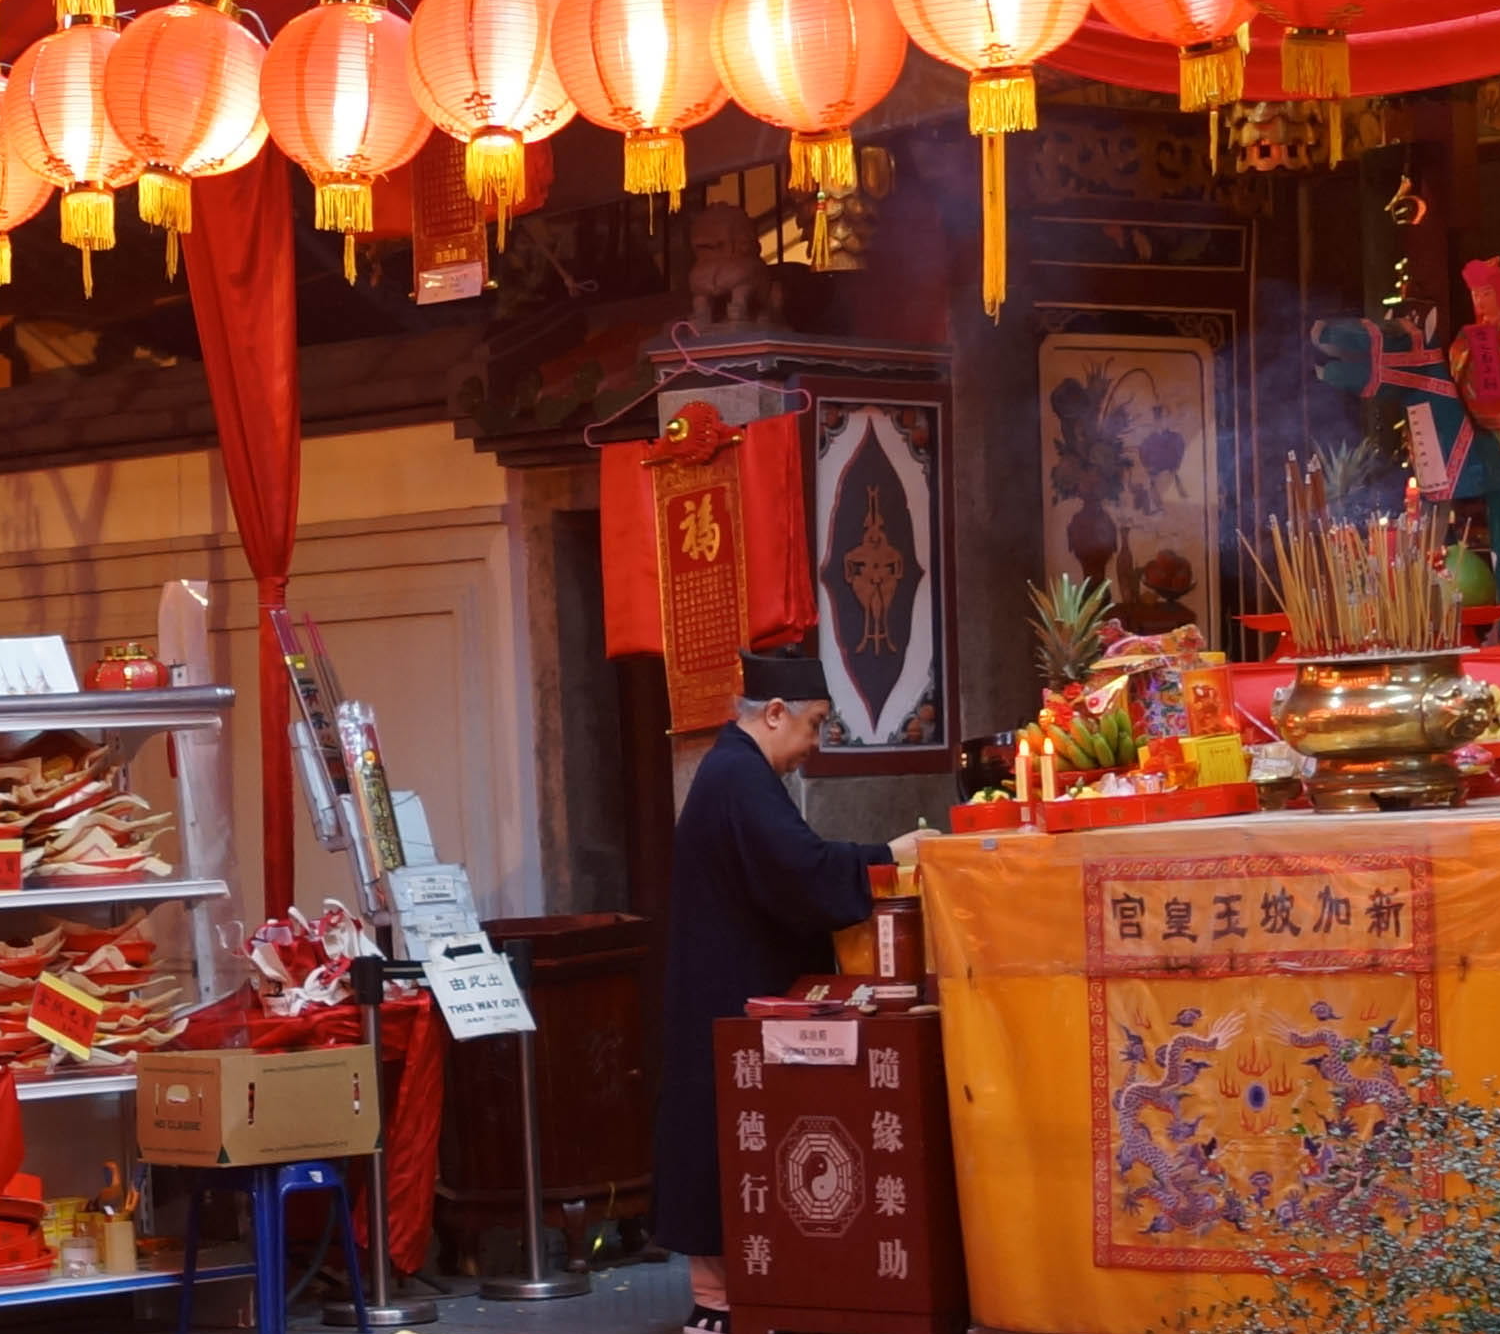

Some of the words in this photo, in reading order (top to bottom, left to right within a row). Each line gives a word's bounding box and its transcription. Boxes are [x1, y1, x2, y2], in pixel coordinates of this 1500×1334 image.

[679, 492, 721, 563] 福
[448, 1002, 475, 1015] THIS
[476, 1000, 500, 1012] WAY
[503, 998, 521, 1009] OUT
[828, 1047, 846, 1058] BOX
[731, 1047, 773, 1276] 積德行善
